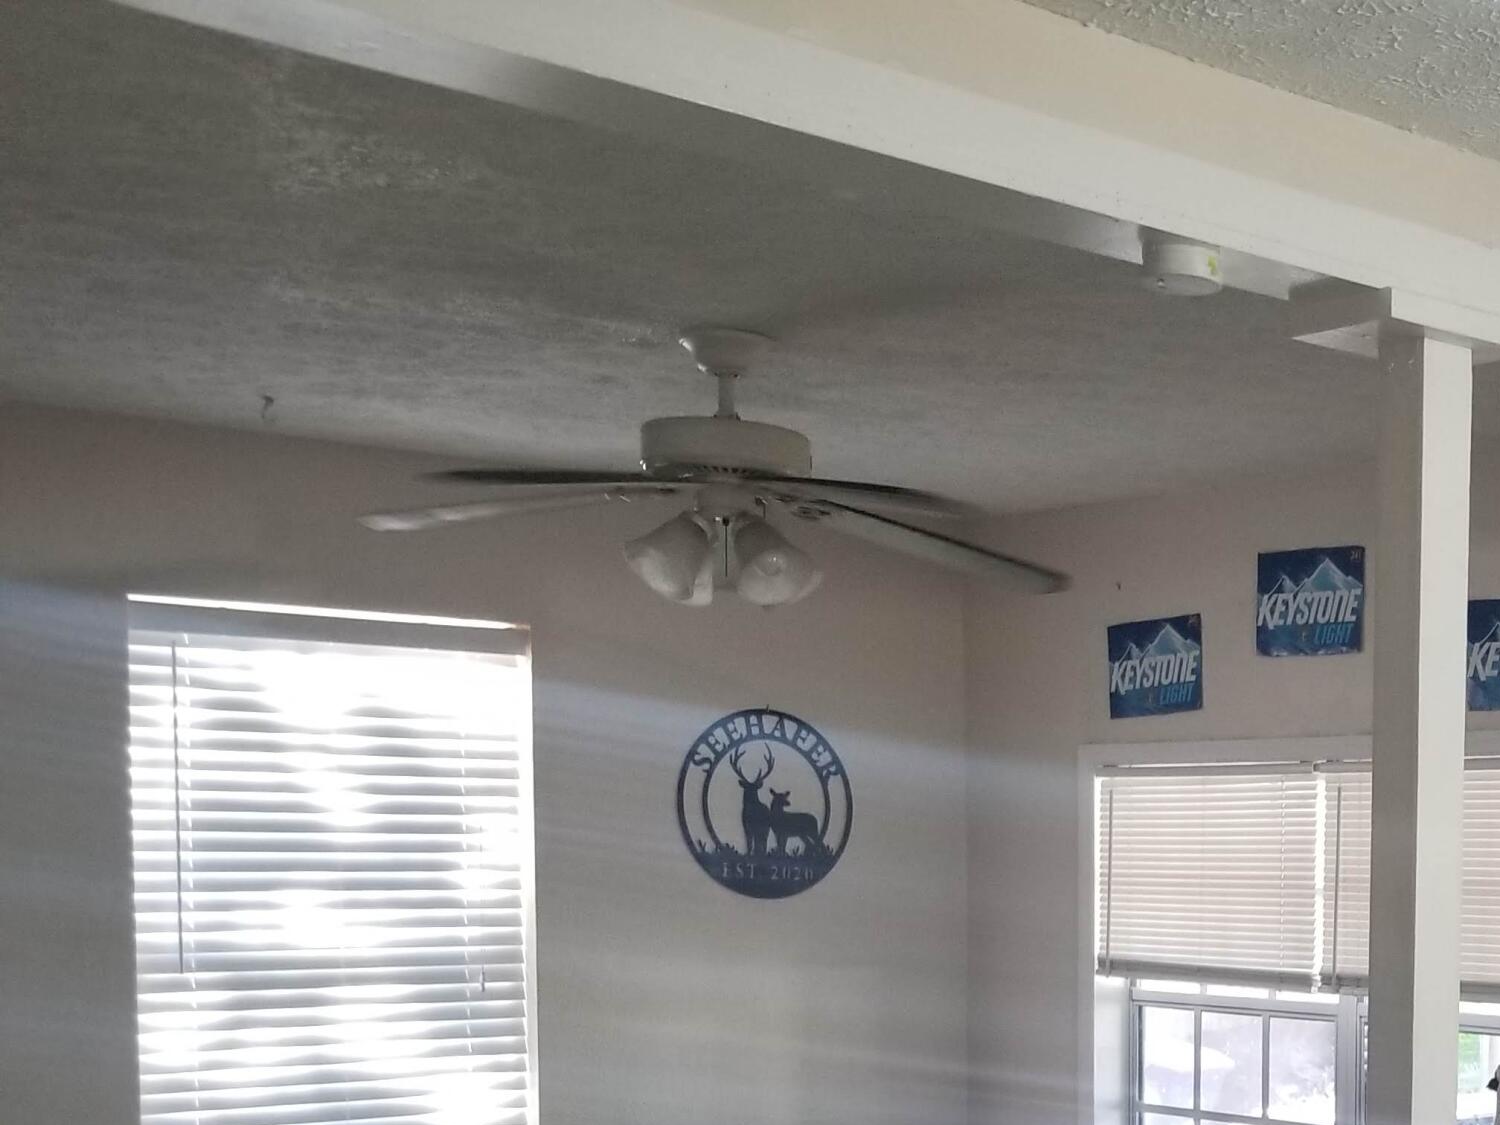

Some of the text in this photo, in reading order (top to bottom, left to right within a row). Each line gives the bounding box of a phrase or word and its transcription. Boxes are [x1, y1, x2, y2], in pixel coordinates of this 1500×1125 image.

[1257, 588, 1362, 630] KEYSTONE
[1315, 623, 1354, 645] LIGHT
[1110, 650, 1200, 695] KEYSTONE
[1160, 684, 1194, 705] LIGHT
